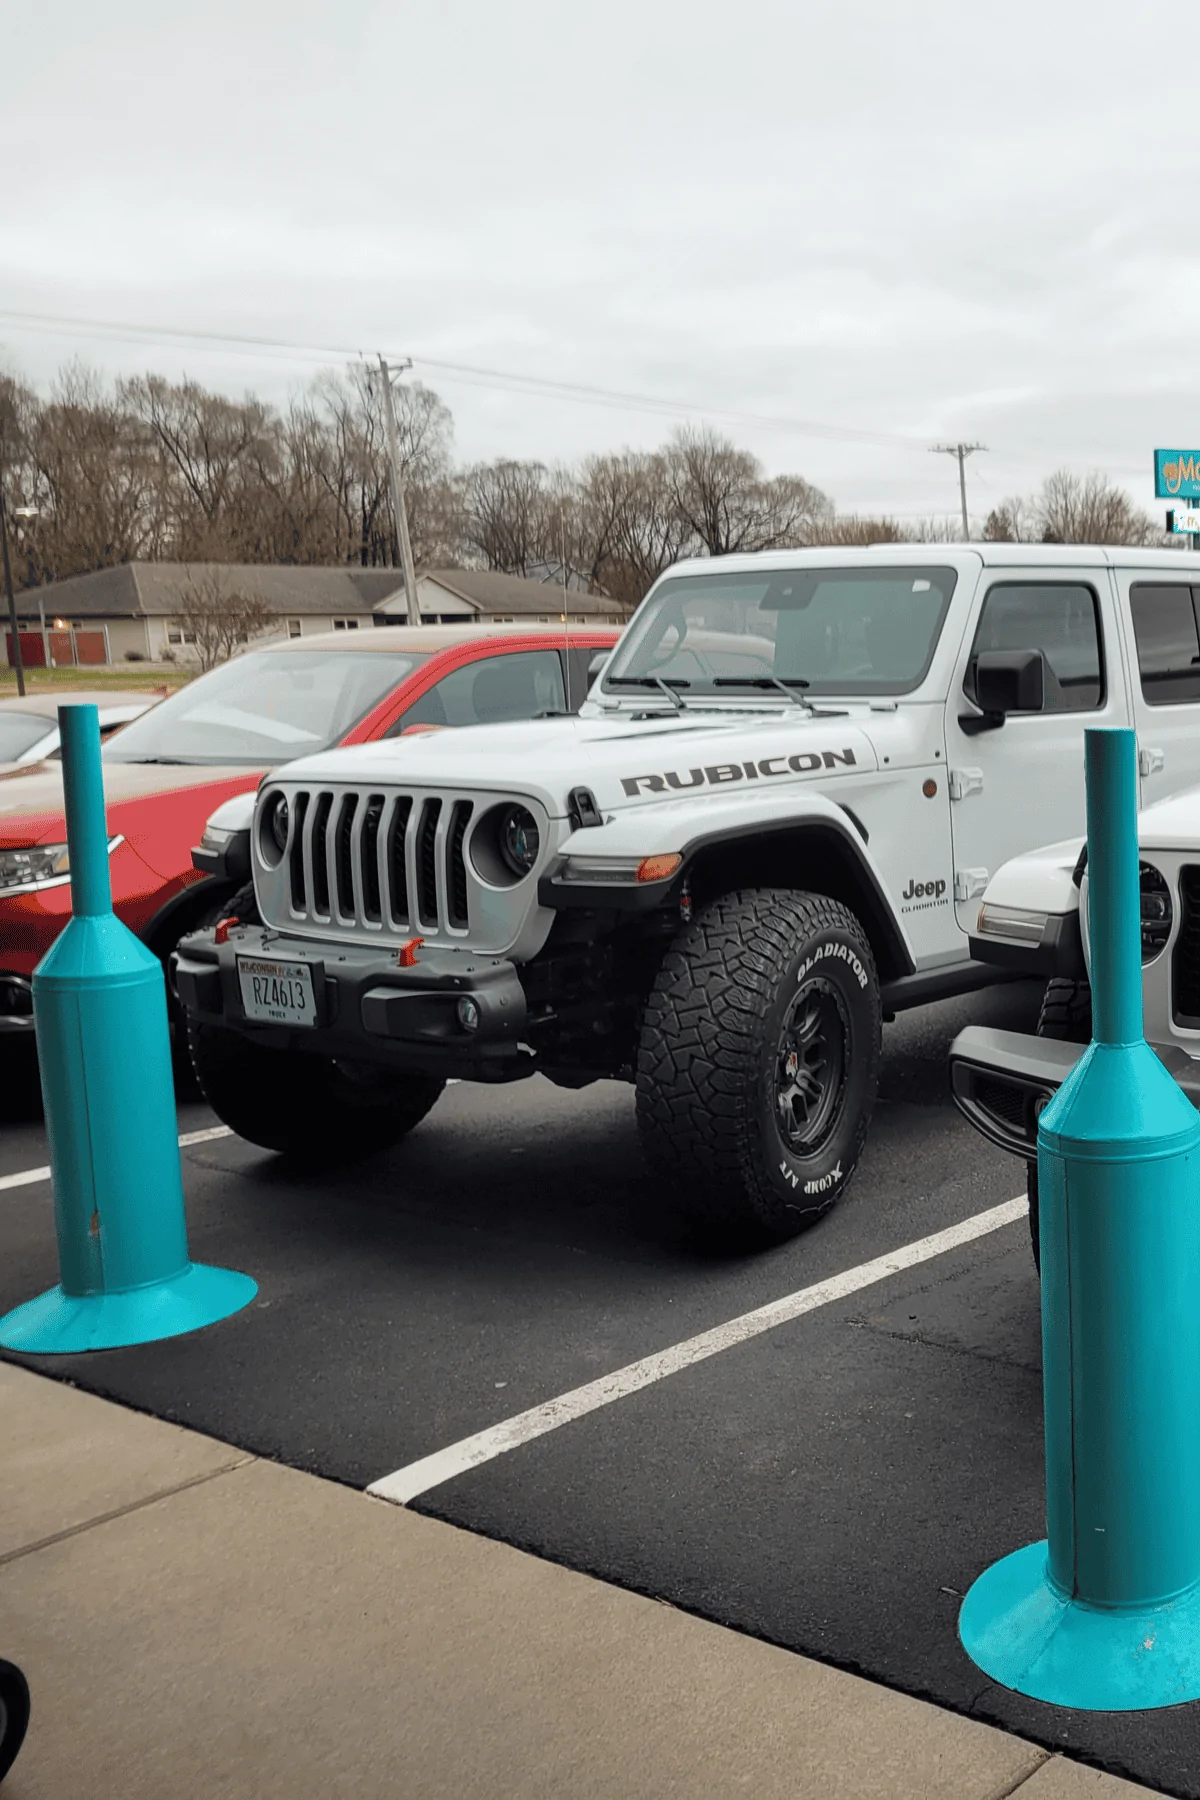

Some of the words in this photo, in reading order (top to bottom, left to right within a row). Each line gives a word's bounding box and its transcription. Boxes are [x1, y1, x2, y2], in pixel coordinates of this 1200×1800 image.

[620, 748, 857, 797] RUBICON
[902, 879, 946, 900] Jeep
[797, 942, 869, 989] GLADIATOR
[252, 976, 305, 1009] RZ4613
